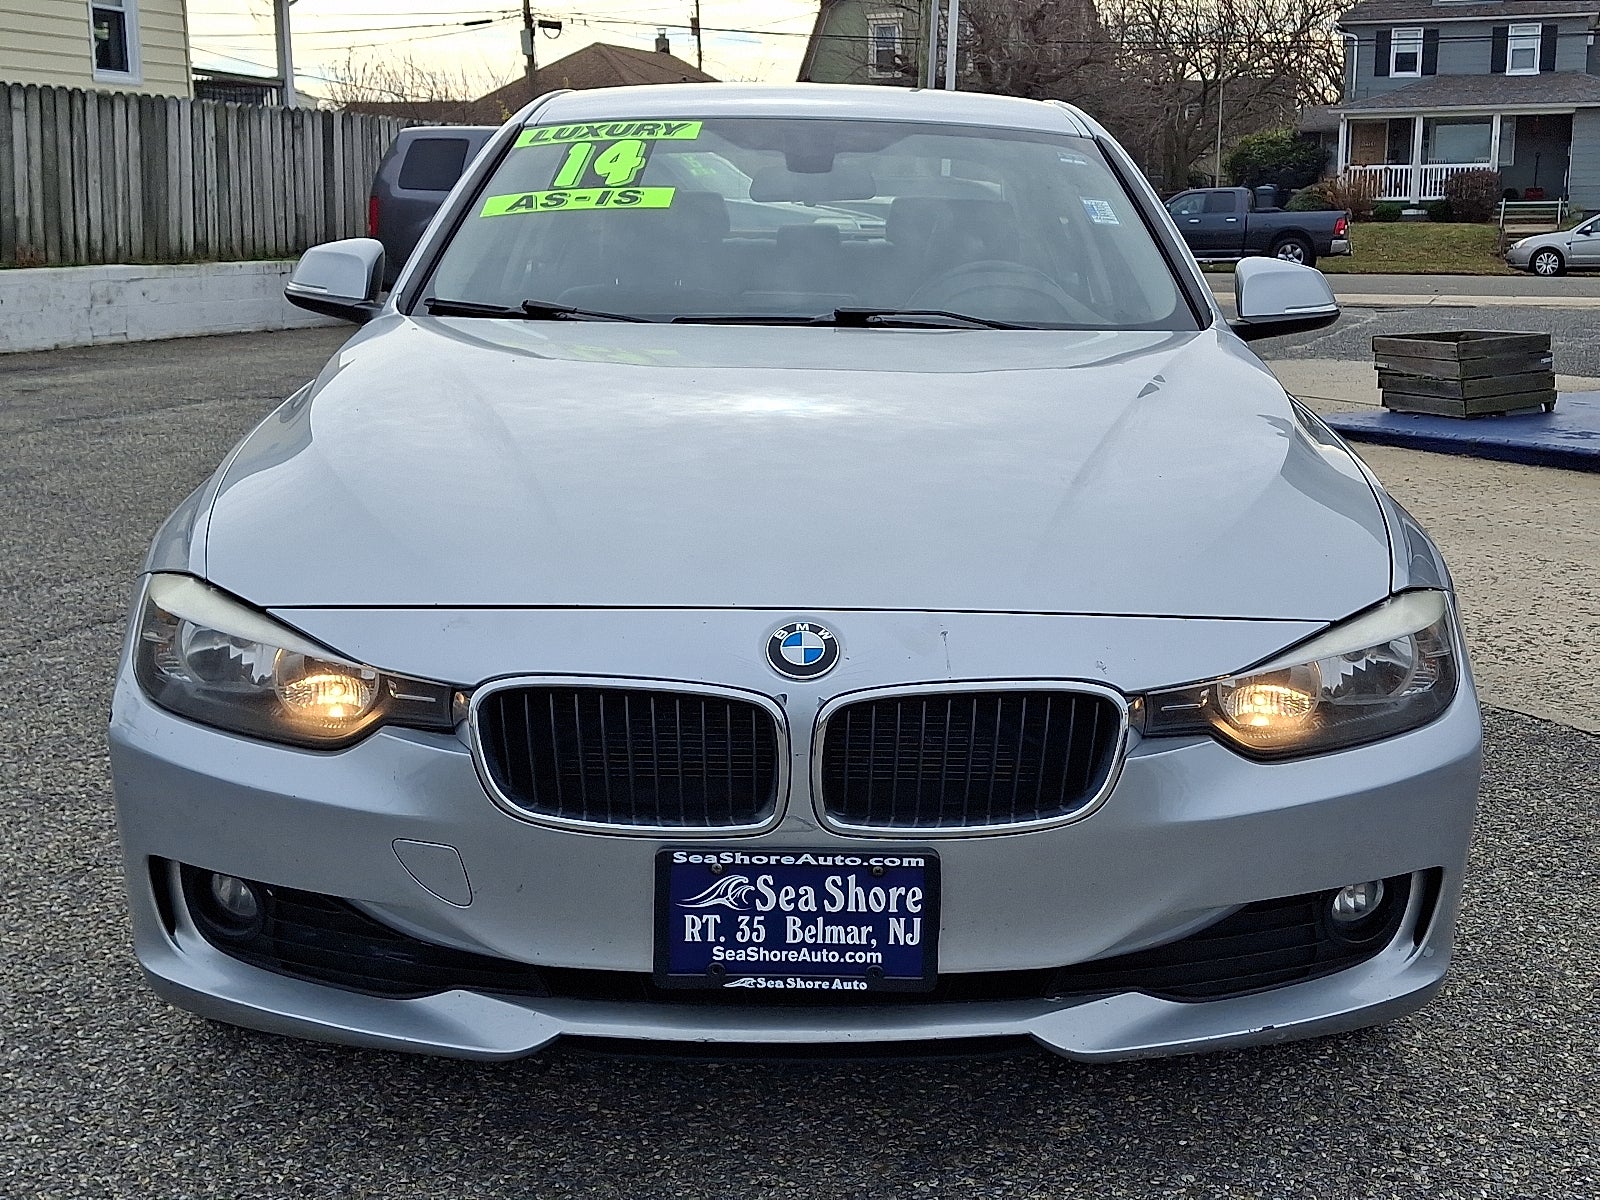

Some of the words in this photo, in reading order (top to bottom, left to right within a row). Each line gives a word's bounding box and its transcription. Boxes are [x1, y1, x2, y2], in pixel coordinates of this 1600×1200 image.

[528, 122, 692, 144] LUXURY
[553, 139, 647, 188] 14
[505, 189, 645, 213] AS-IS
[773, 623, 833, 640] BMW
[672, 852, 925, 867] SeaShoreAuto.com
[755, 874, 817, 912] Sea
[823, 874, 923, 913] Shore
[683, 914, 726, 943] RT.
[735, 915, 766, 943] 35
[785, 916, 877, 948] Belmar,
[888, 917, 921, 946] NJ
[712, 946, 882, 964] SeaShoreAuto.com
[756, 977, 785, 989] Sea
[786, 977, 830, 990] Shore
[831, 979, 868, 990] Auto
